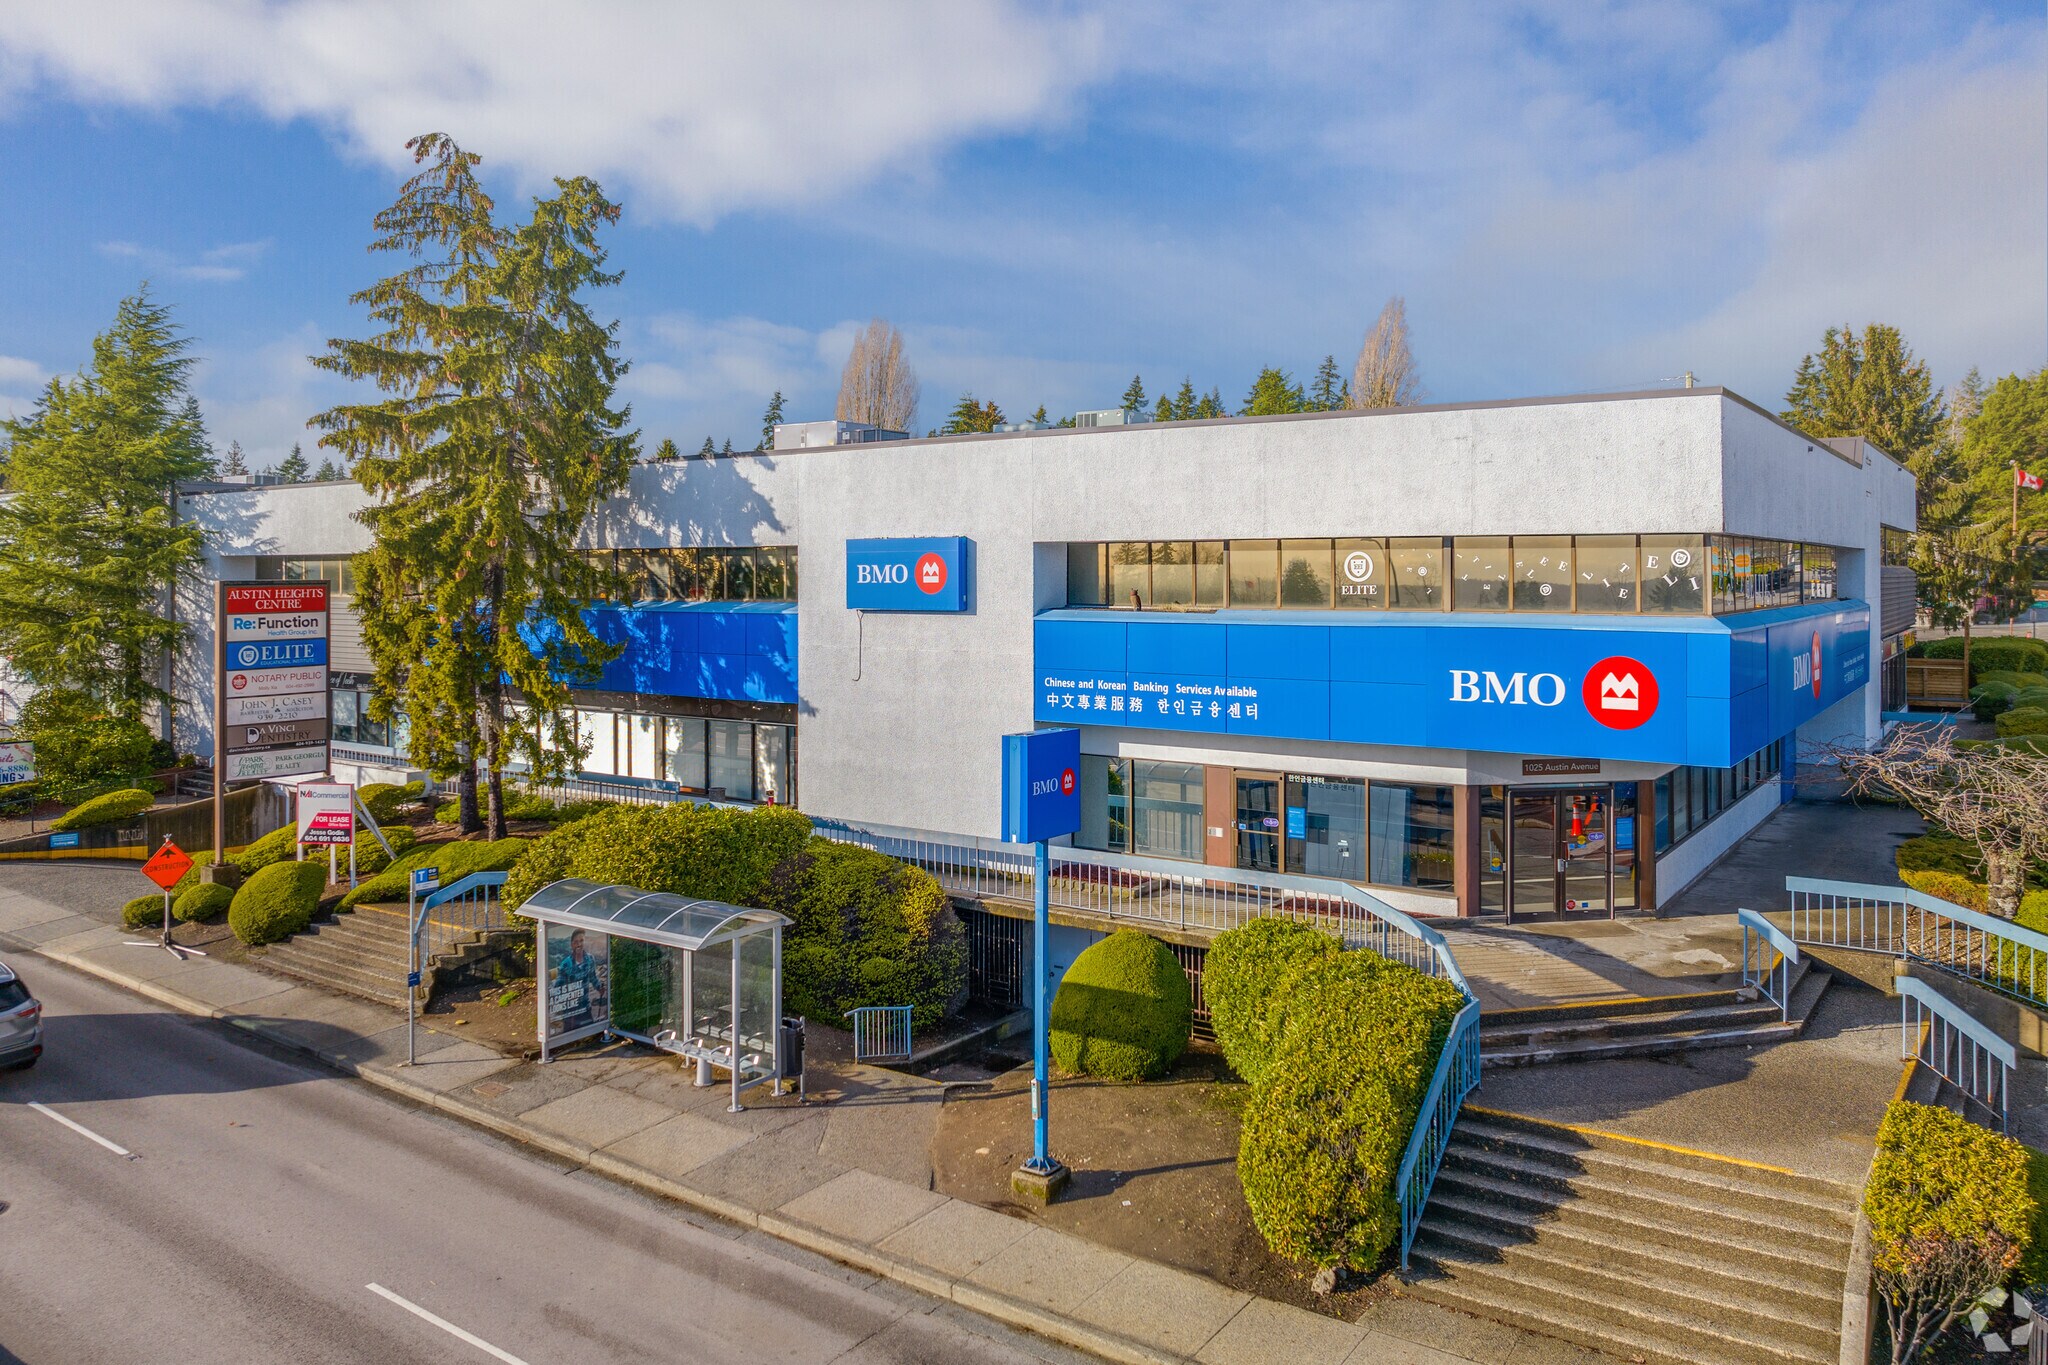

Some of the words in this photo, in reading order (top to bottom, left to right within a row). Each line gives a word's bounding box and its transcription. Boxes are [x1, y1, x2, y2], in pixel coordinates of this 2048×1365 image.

[857, 564, 908, 584] BMO
[228, 589, 271, 600] AUSTIN
[275, 588, 323, 599] HEIGHTS
[1341, 584, 1377, 595] ELITE
[255, 599, 302, 610] CENTRE
[233, 617, 256, 630] Re:
[258, 616, 318, 630] Function
[288, 629, 307, 637] Group
[262, 643, 315, 660] ELITE
[251, 674, 288, 683] NOTARY
[290, 671, 322, 681] PUBLIC
[1793, 652, 1811, 691] BMO
[1044, 677, 1076, 688] Chinese
[1078, 679, 1094, 689] and
[1098, 680, 1127, 691] Korean
[1133, 681, 1169, 695] Banking
[1176, 683, 1212, 695] Services
[1213, 685, 1258, 698] Available
[1449, 669, 1566, 707] BMO
[240, 700, 267, 711] JOHN
[271, 698, 279, 708] J.
[282, 697, 314, 706] CASEY
[1046, 692, 1143, 712] 中文專業服務
[1157, 698, 1258, 720] 한인금융센터
[268, 724, 296, 733] VINCI
[294, 752, 324, 760] GEORGIA
[275, 762, 301, 770] REALTY
[1525, 764, 1543, 772] 1025
[1545, 763, 1568, 772] Austin
[1571, 762, 1599, 771] Avenue
[1032, 778, 1058, 796] BMO
[145, 861, 190, 873] CONSTRUCTION
[549, 986, 561, 997] THIS
[561, 984, 568, 993] IS
[568, 980, 584, 992] WHAT
[549, 997, 554, 1006] A
[554, 988, 585, 1004] CARPENTER
[549, 1002, 567, 1014] LOOKS
[567, 998, 580, 1010] LIKE
